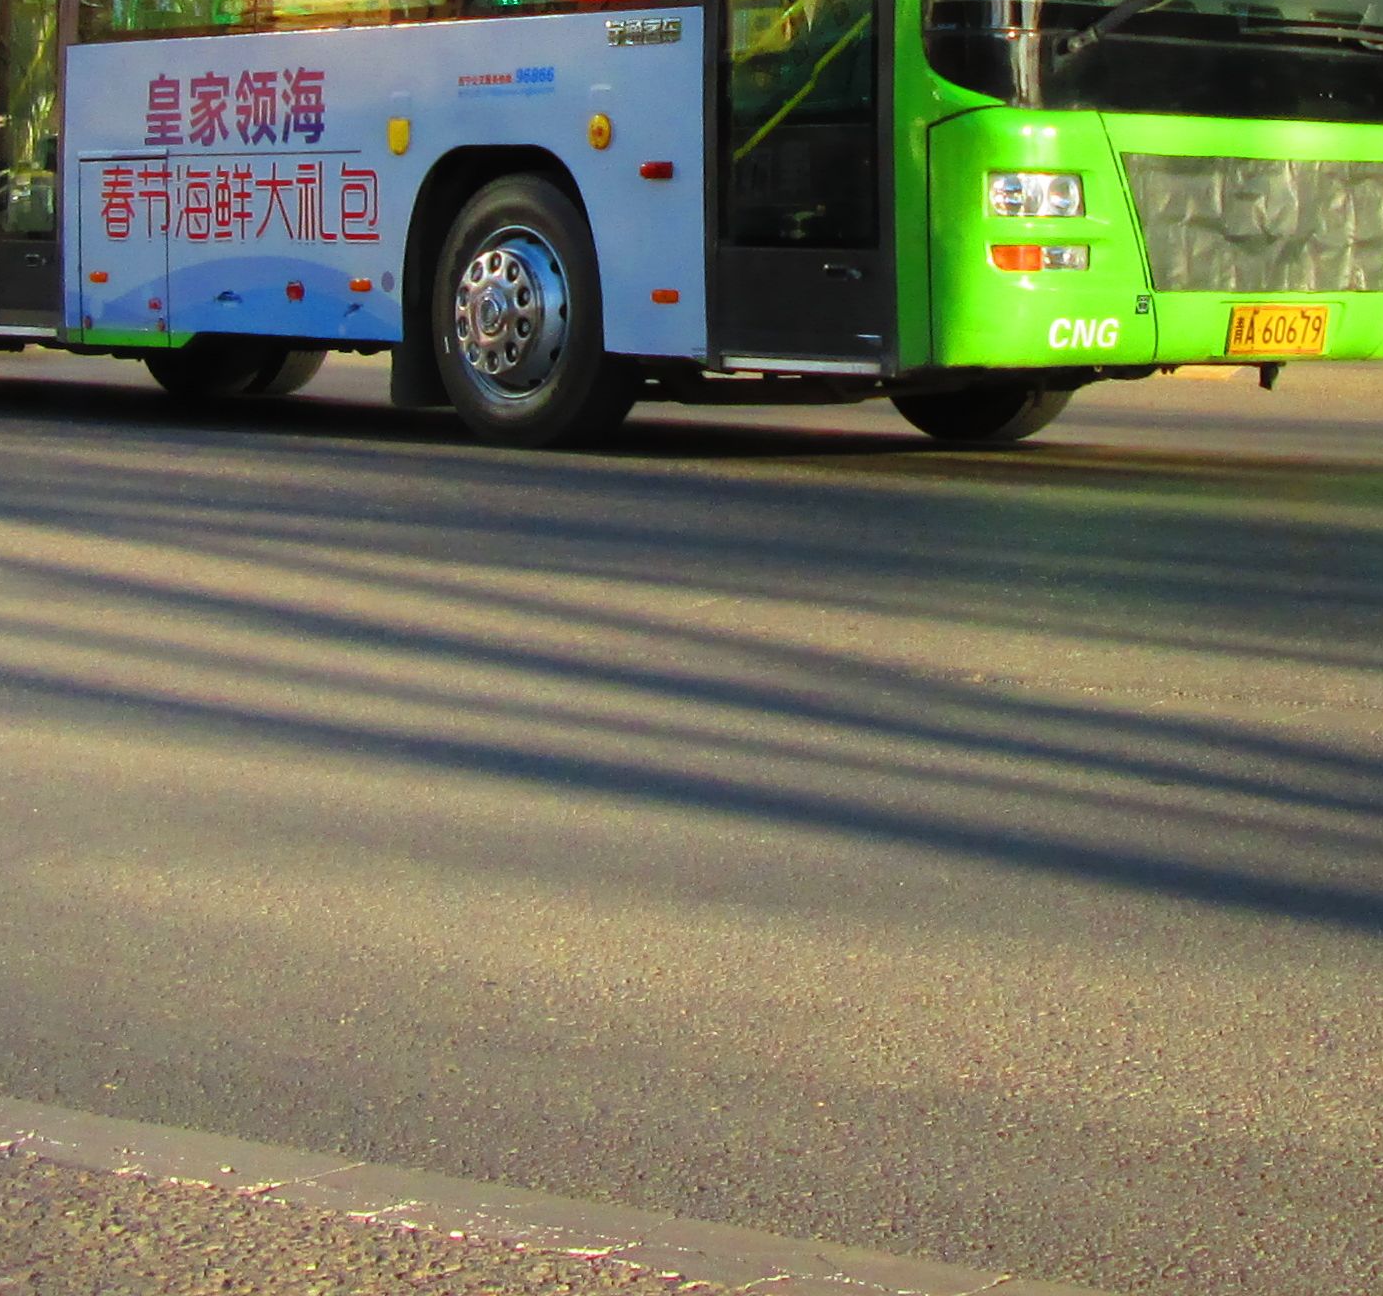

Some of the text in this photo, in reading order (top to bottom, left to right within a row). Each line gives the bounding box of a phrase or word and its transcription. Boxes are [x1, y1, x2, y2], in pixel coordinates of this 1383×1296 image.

[144, 67, 326, 147] 皇家领海
[100, 162, 381, 245] 春节海鲜大礼包
[1048, 317, 1120, 350] CNG
